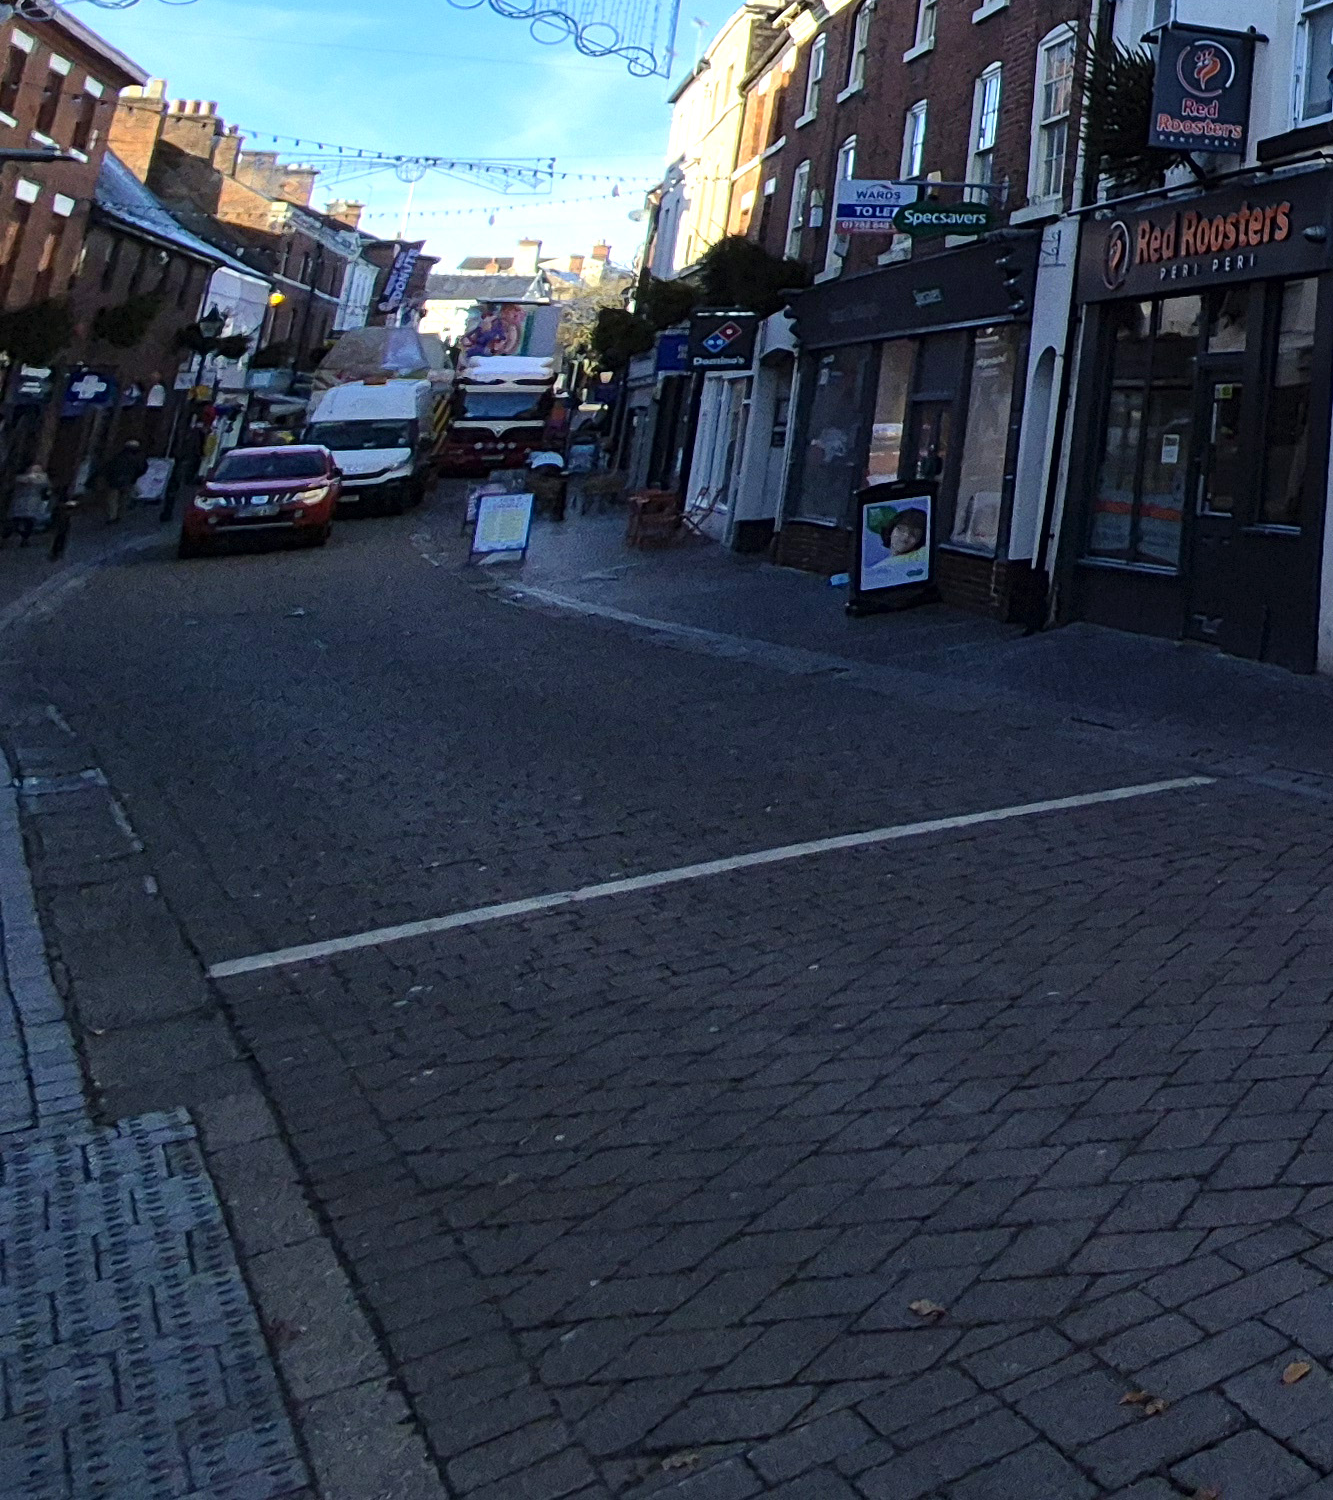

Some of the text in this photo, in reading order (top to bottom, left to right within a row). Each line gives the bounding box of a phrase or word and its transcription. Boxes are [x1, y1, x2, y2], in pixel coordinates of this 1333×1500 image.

[1181, 98, 1219, 119] Red
[1157, 113, 1242, 139] Roosters
[856, 190, 901, 200] WARDS
[854, 206, 873, 216] TO
[904, 210, 987, 226] Specsavers
[1135, 200, 1291, 265] Red Roosters
[1160, 253, 1255, 281] PERI PERI
